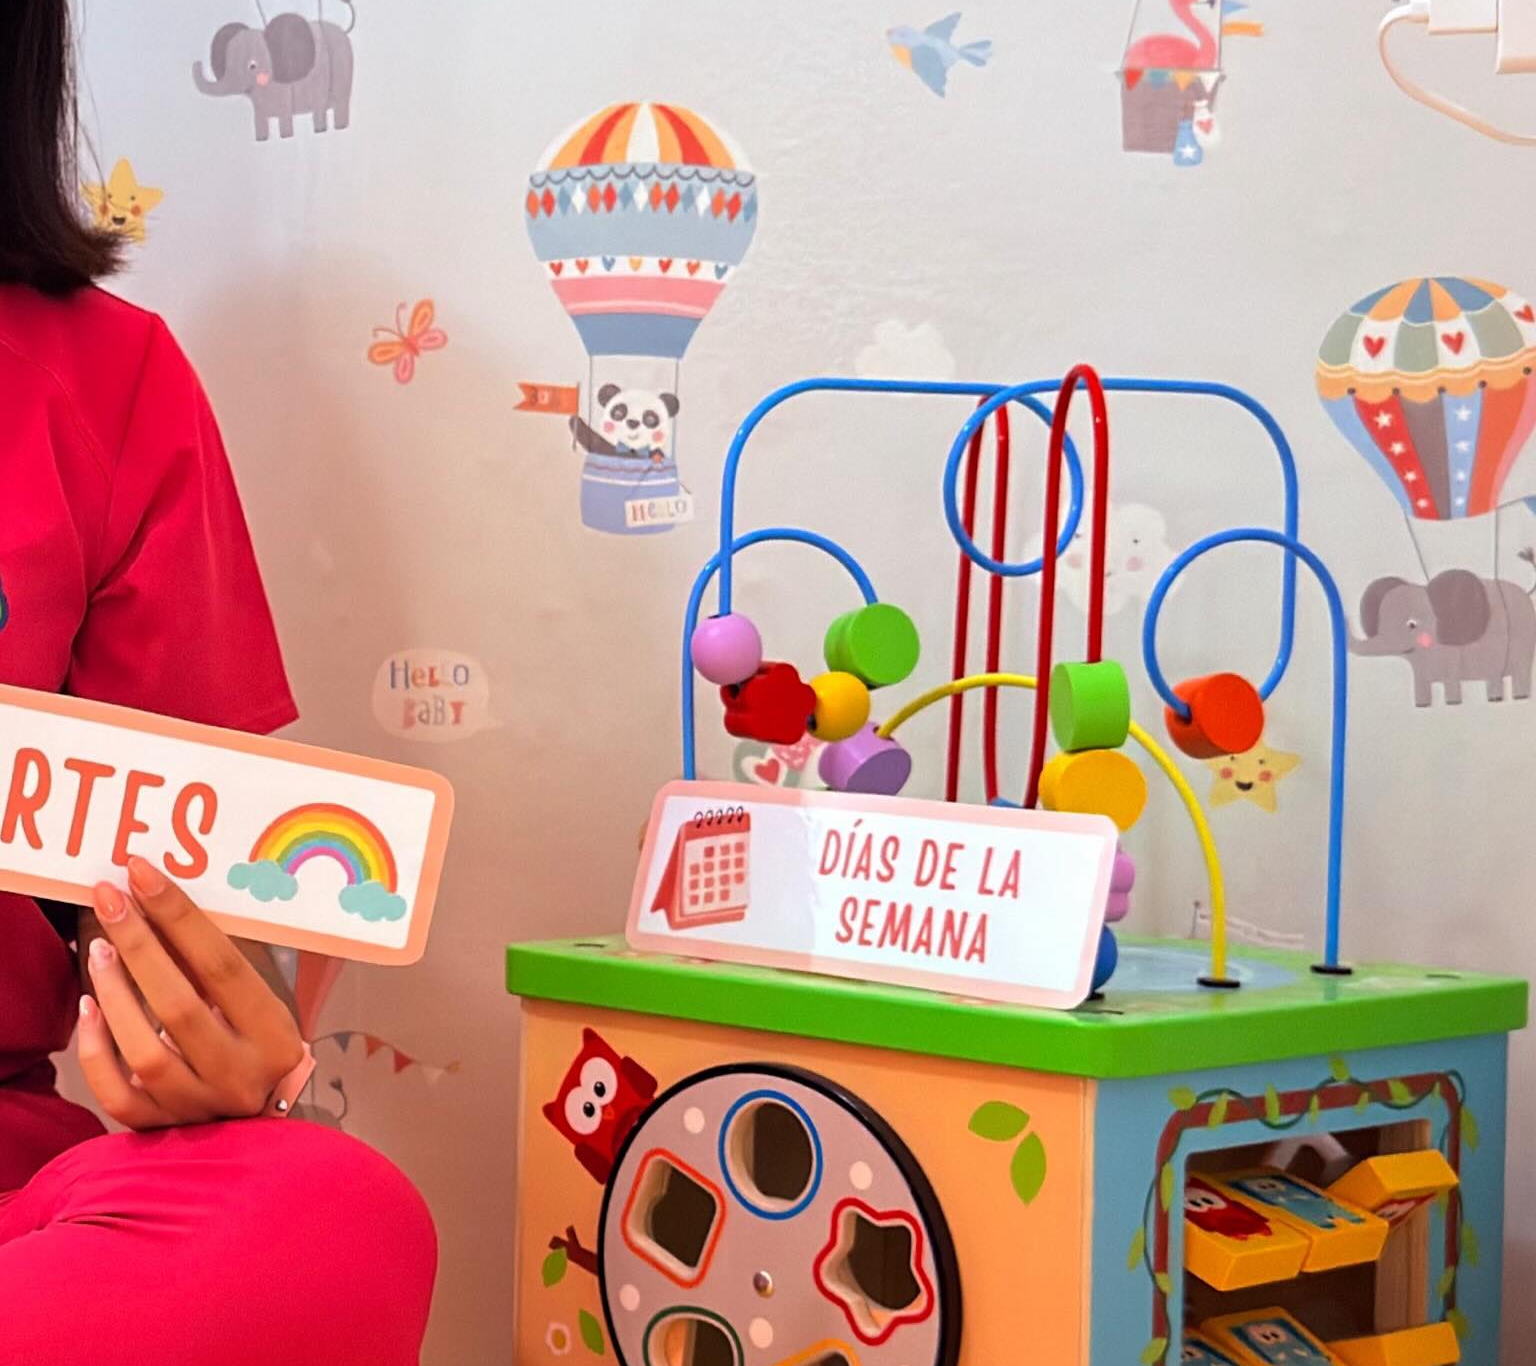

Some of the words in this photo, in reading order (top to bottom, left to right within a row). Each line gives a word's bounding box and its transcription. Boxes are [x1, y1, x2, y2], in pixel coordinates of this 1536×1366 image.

[819, 819, 901, 883] DÍAS
[914, 838, 965, 891] DE
[977, 846, 1023, 900] LA
[835, 896, 990, 963] SEMANA
